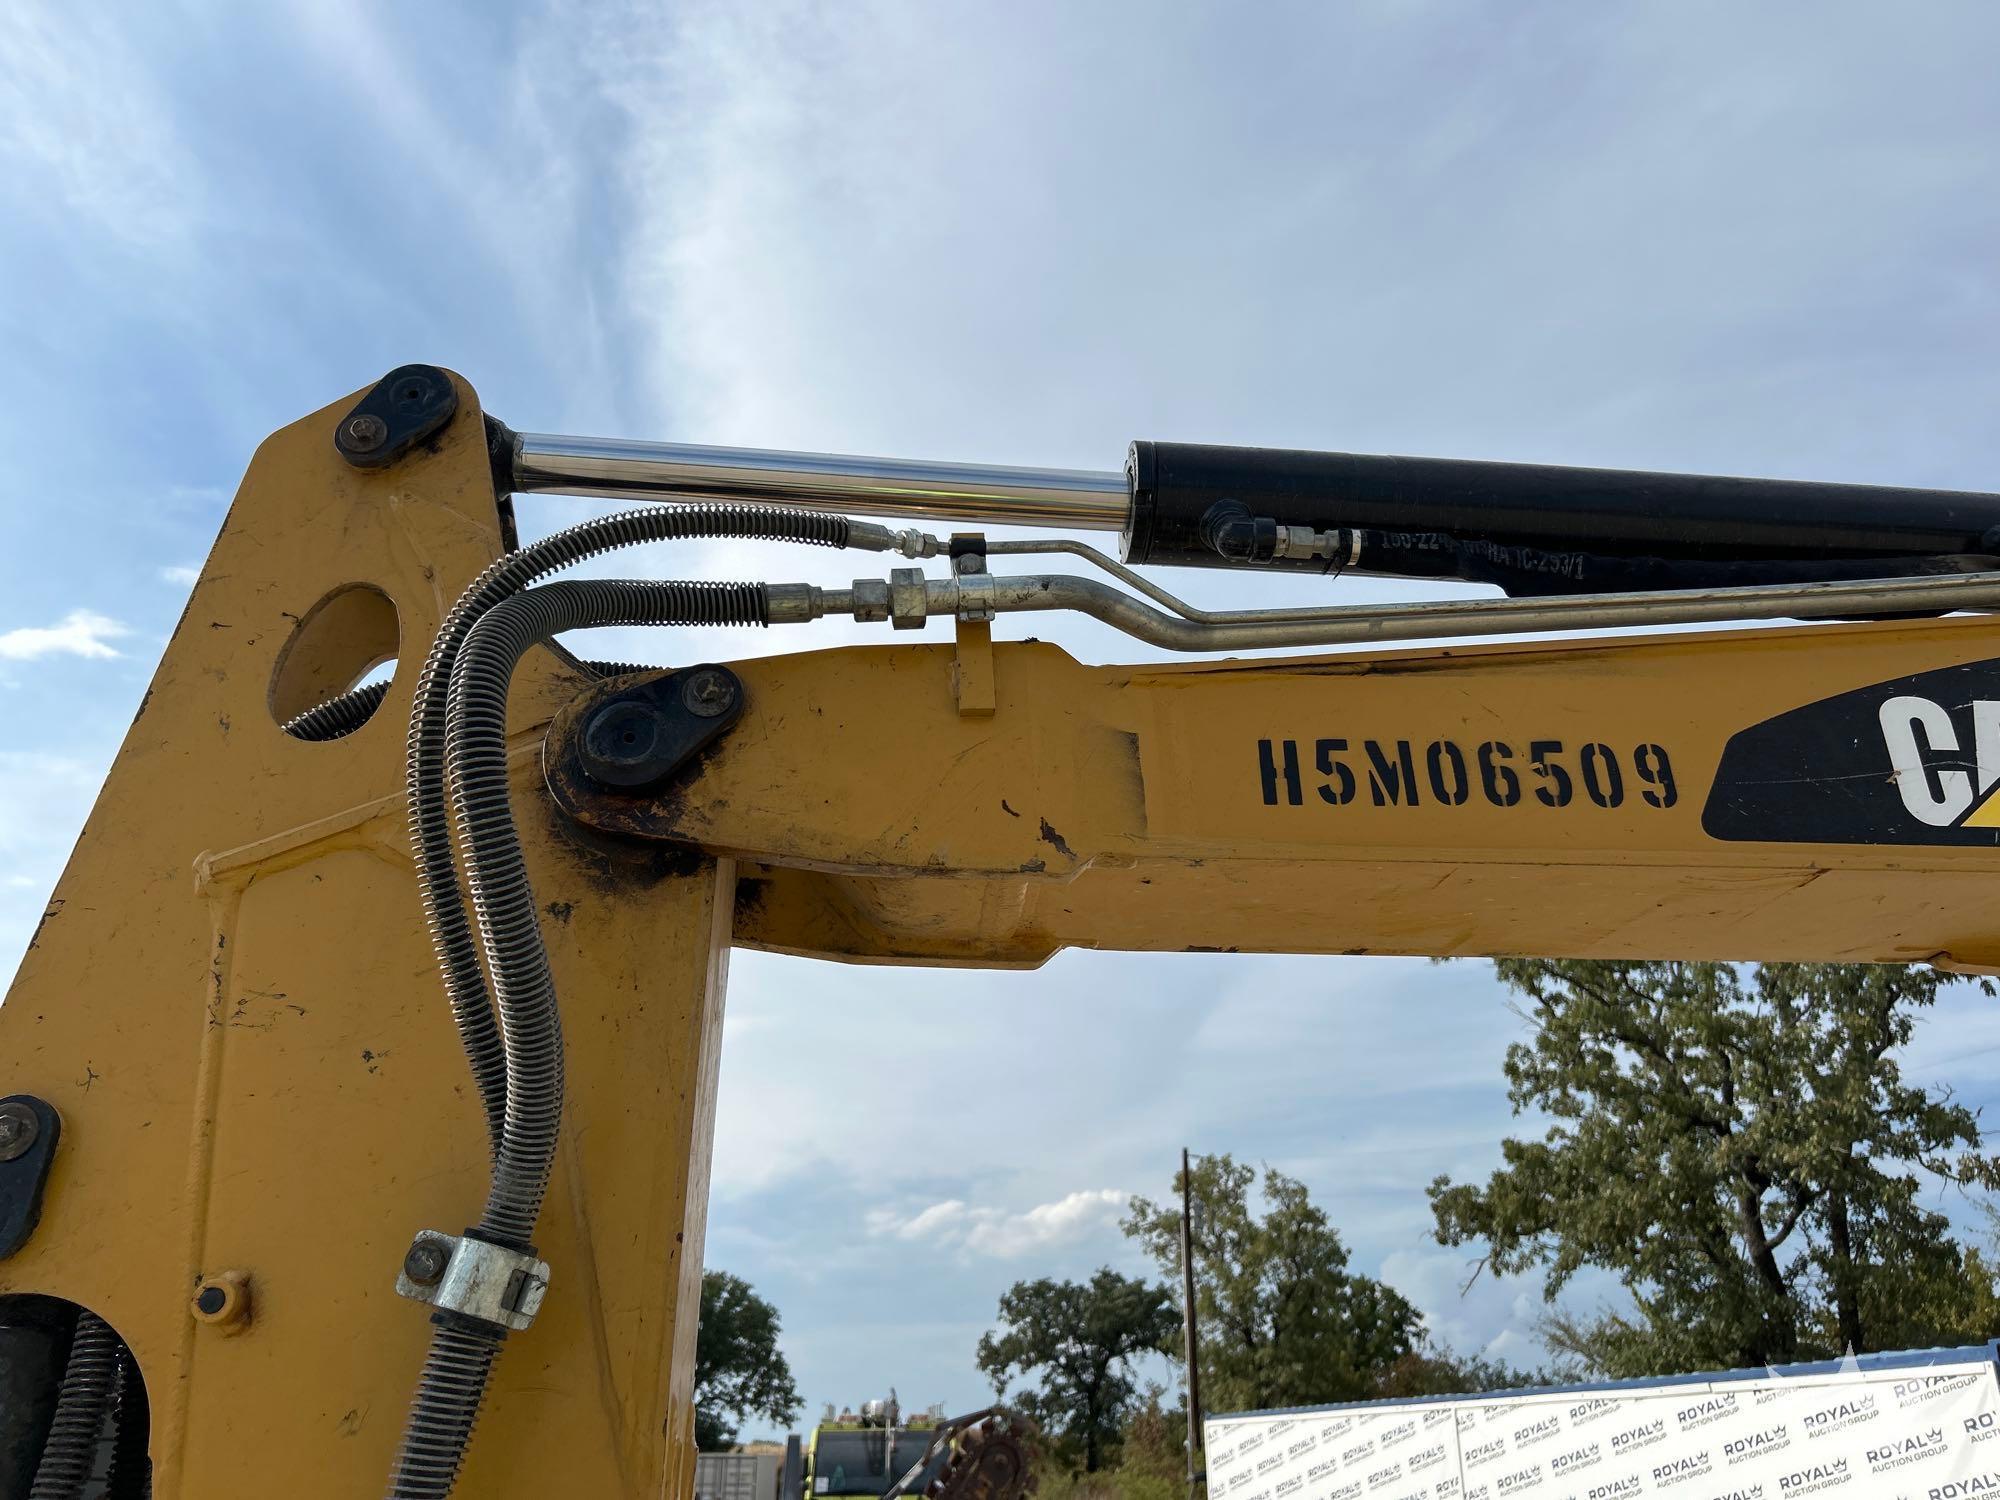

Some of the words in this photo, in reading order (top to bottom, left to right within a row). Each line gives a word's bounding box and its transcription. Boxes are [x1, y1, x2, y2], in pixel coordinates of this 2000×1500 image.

[1257, 738, 1679, 809] H5M06509
[1900, 1389, 1941, 1408] AUCTION
[1943, 1376, 1978, 1393] GROUP
[1678, 1399, 1724, 1422] ROYAL
[1682, 1416, 1712, 1432] AUCTION
[1714, 1406, 1739, 1421] GROUP
[1804, 1402, 1861, 1429] ROYAL
[1514, 1424, 1549, 1440] ROYAL
[1612, 1425, 1653, 1447] ROYAL
[1809, 1421, 1846, 1438] AUCTION
[1848, 1410, 1879, 1425] GROUP
[1466, 1442, 1496, 1461] ROYAL
[1615, 1442, 1643, 1456] AUCTION
[1644, 1433, 1667, 1446] GROUP
[1724, 1431, 1774, 1456] ROYAL
[1729, 1450, 1761, 1465] AUCTION
[1763, 1440, 1790, 1455] GROUP
[1866, 1436, 1928, 1464] ROYAL
[1552, 1449, 1589, 1469] ROYAL
[1653, 1457, 1697, 1479] ROYAL
[1872, 1455, 1913, 1474] AUCTION
[1914, 1445, 1948, 1461] GROUP
[1498, 1469, 1532, 1488] ROYAL
[1657, 1474, 1686, 1488] AUCTION
[1688, 1465, 1712, 1478] GROUP
[1779, 1464, 1834, 1490] ROYAL
[1784, 1484, 1821, 1500] AUCTION
[1822, 1474, 1852, 1488] GROUP
[1928, 1475, 1997, 1500] ROYAL
[1588, 1480, 1629, 1500] ROYAL
